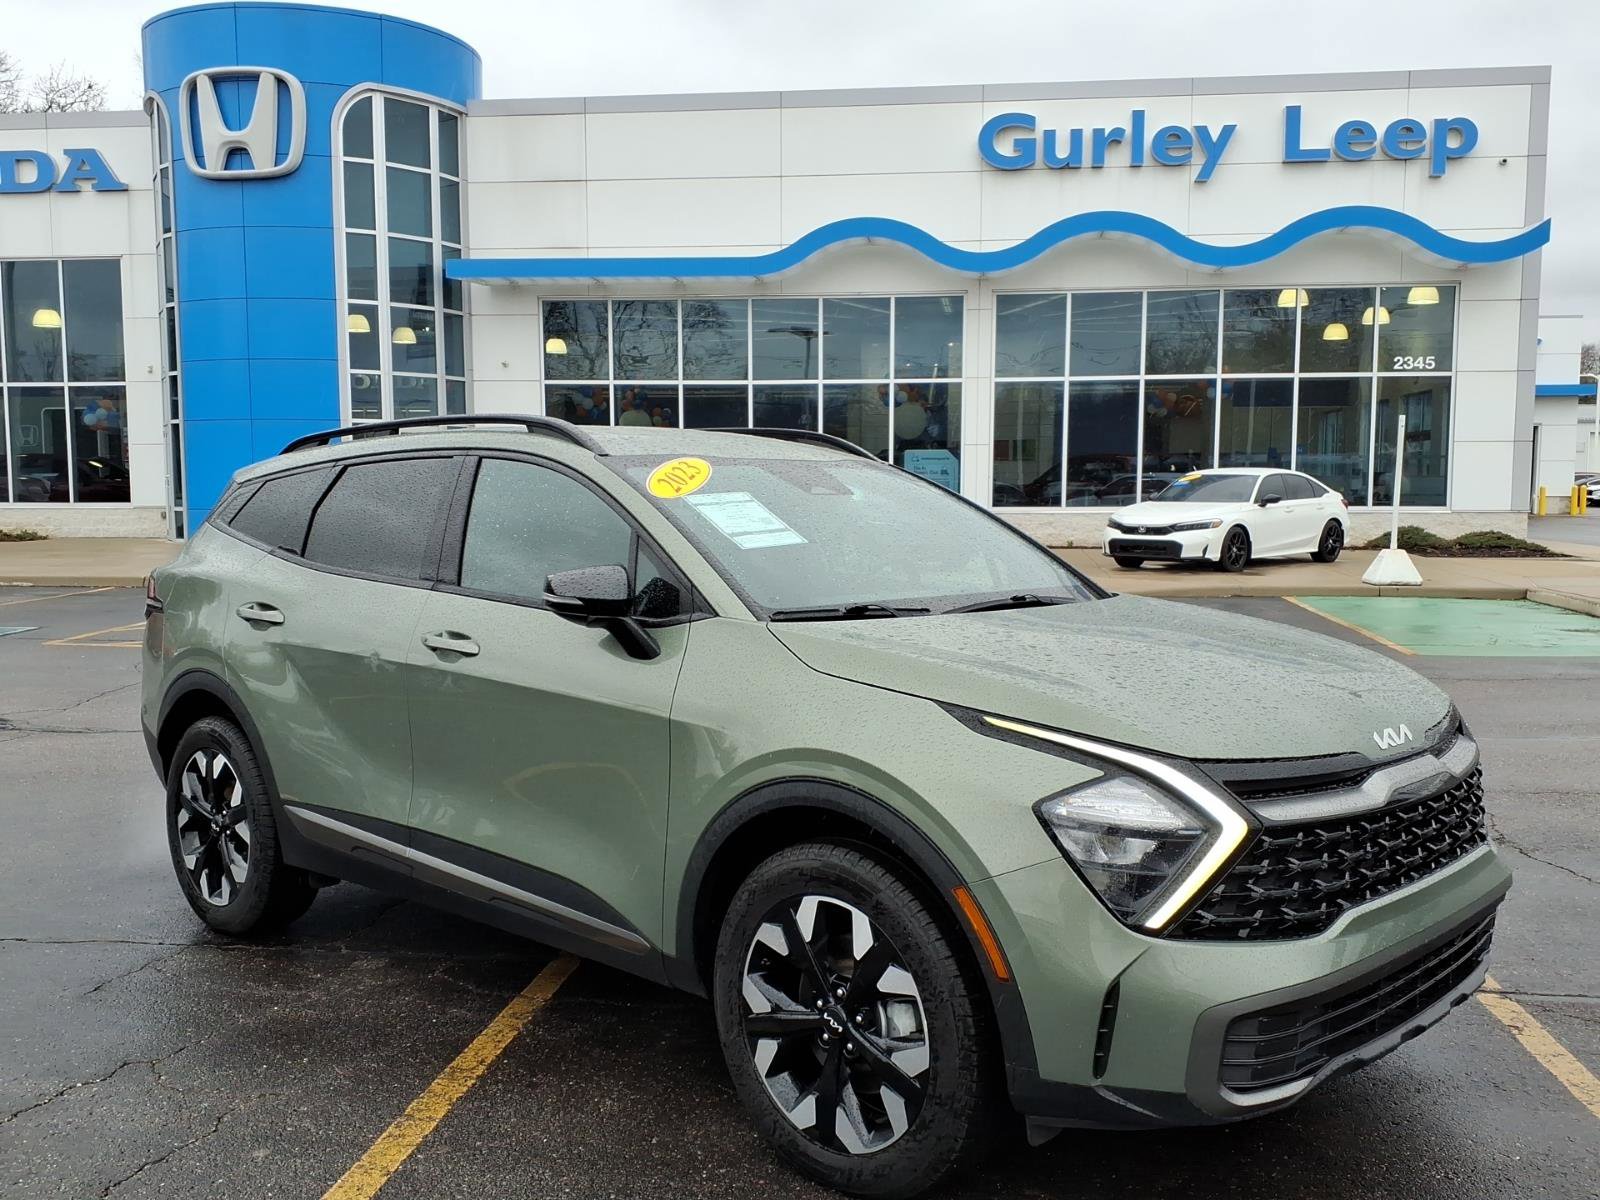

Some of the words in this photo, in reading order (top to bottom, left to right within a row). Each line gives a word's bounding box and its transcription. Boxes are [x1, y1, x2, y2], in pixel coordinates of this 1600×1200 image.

[977, 109, 1238, 183] Gurley
[1284, 104, 1479, 177] Leep
[1392, 355, 1436, 370] 2345
[656, 460, 702, 494] 2023
